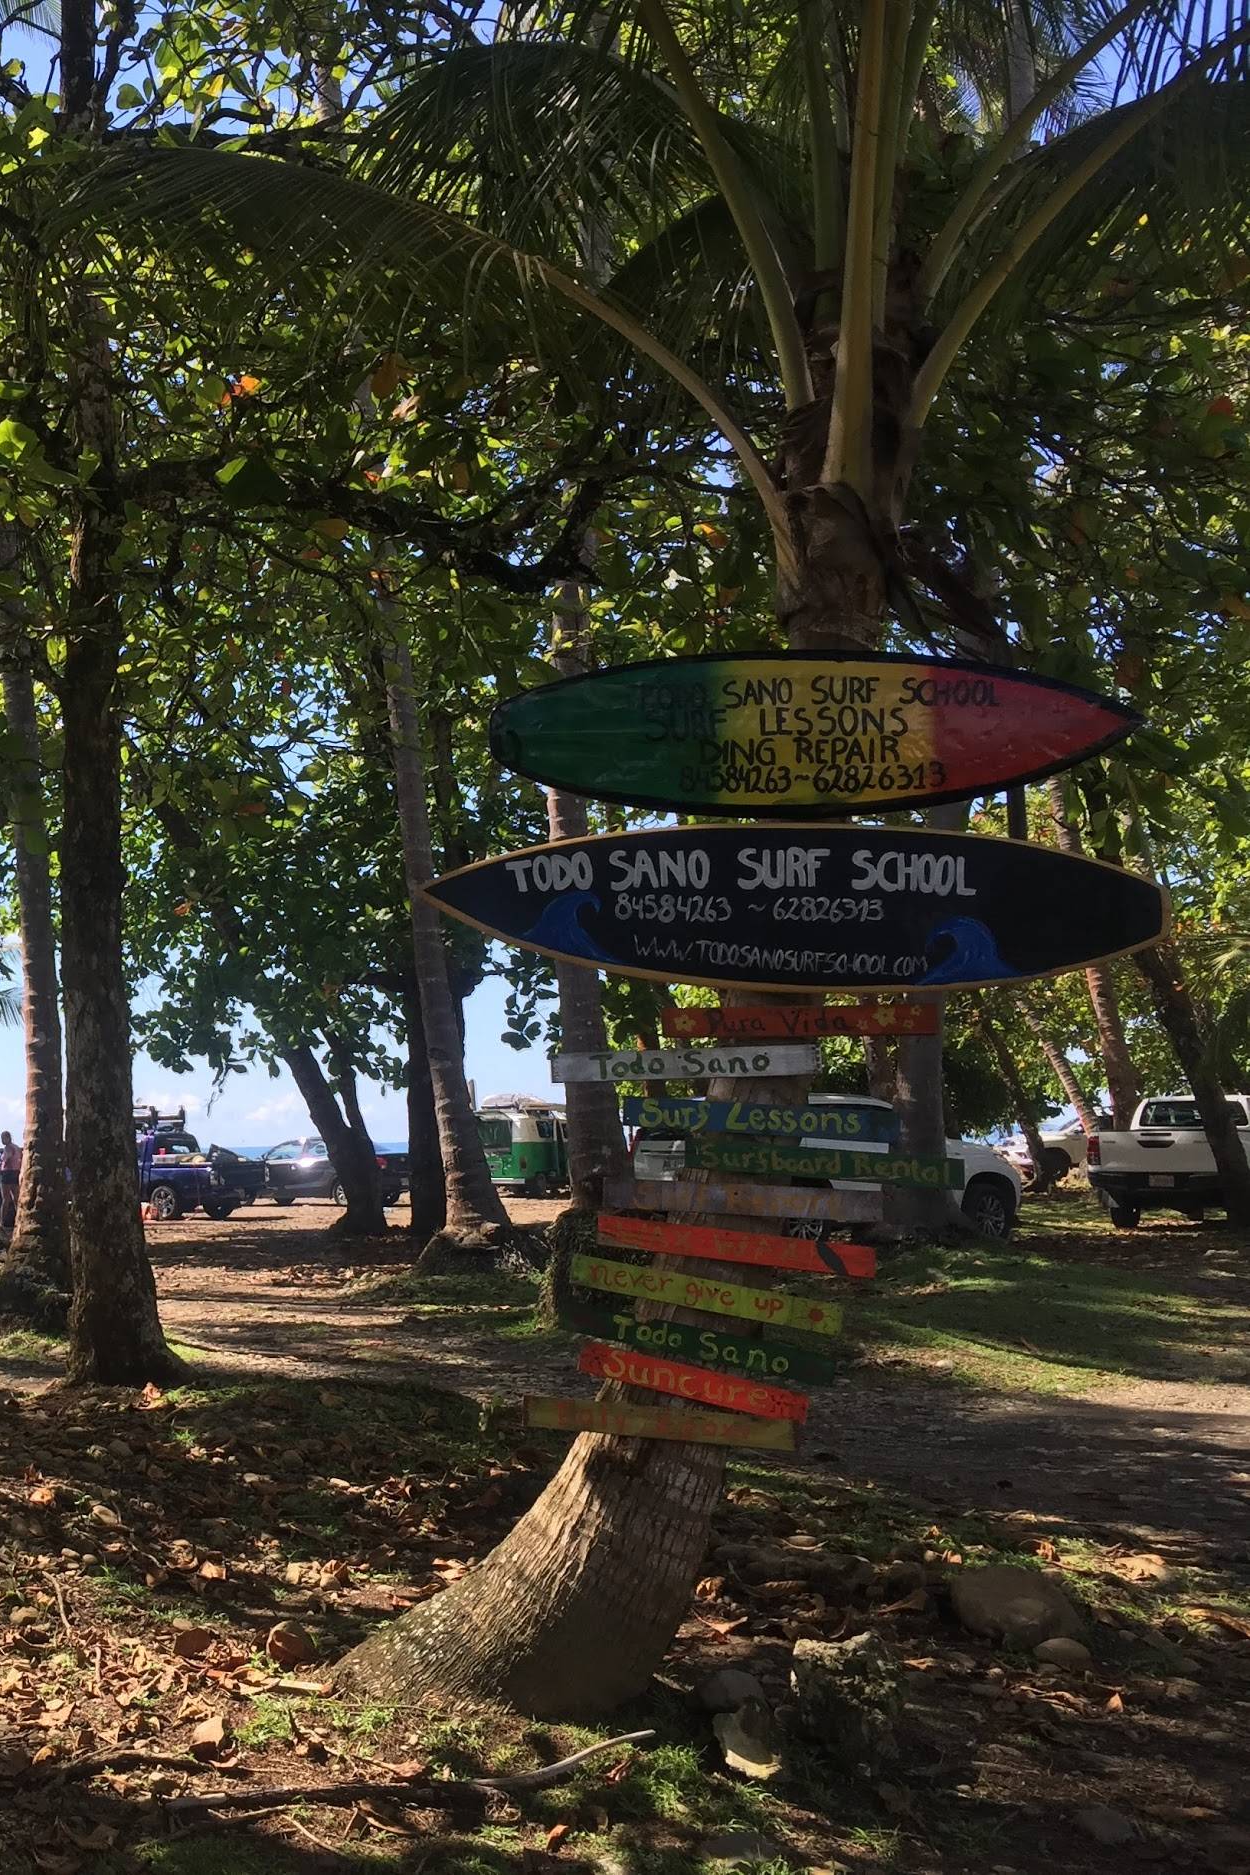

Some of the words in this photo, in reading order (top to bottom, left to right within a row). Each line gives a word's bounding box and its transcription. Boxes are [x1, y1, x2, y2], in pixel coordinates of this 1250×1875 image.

[723, 677, 793, 708] SANO
[811, 675, 880, 704] SURF
[899, 678, 1001, 707] SCHOOL
[645, 708, 726, 742] SURF
[759, 707, 908, 737] LESSONS
[699, 738, 776, 766] DING
[794, 735, 900, 764] REPAIR
[505, 850, 594, 892] TODO
[609, 848, 710, 891] SANO
[737, 847, 831, 889] SURF
[851, 849, 977, 896] SCHOOL
[614, 893, 732, 922] 84584263
[706, 1009, 766, 1034] Pura
[781, 1010, 851, 1034] Vida
[589, 1053, 665, 1081] Todo
[681, 1049, 771, 1076] Sano
[638, 1099, 711, 1132] Surf
[724, 1101, 862, 1135] Lessons
[700, 1146, 842, 1175] Surfboard
[853, 1156, 950, 1185] Rental
[589, 1264, 674, 1292] never
[685, 1281, 736, 1307] give
[753, 1296, 785, 1319] up
[613, 1313, 683, 1347] Todo
[699, 1331, 790, 1374] Sano
